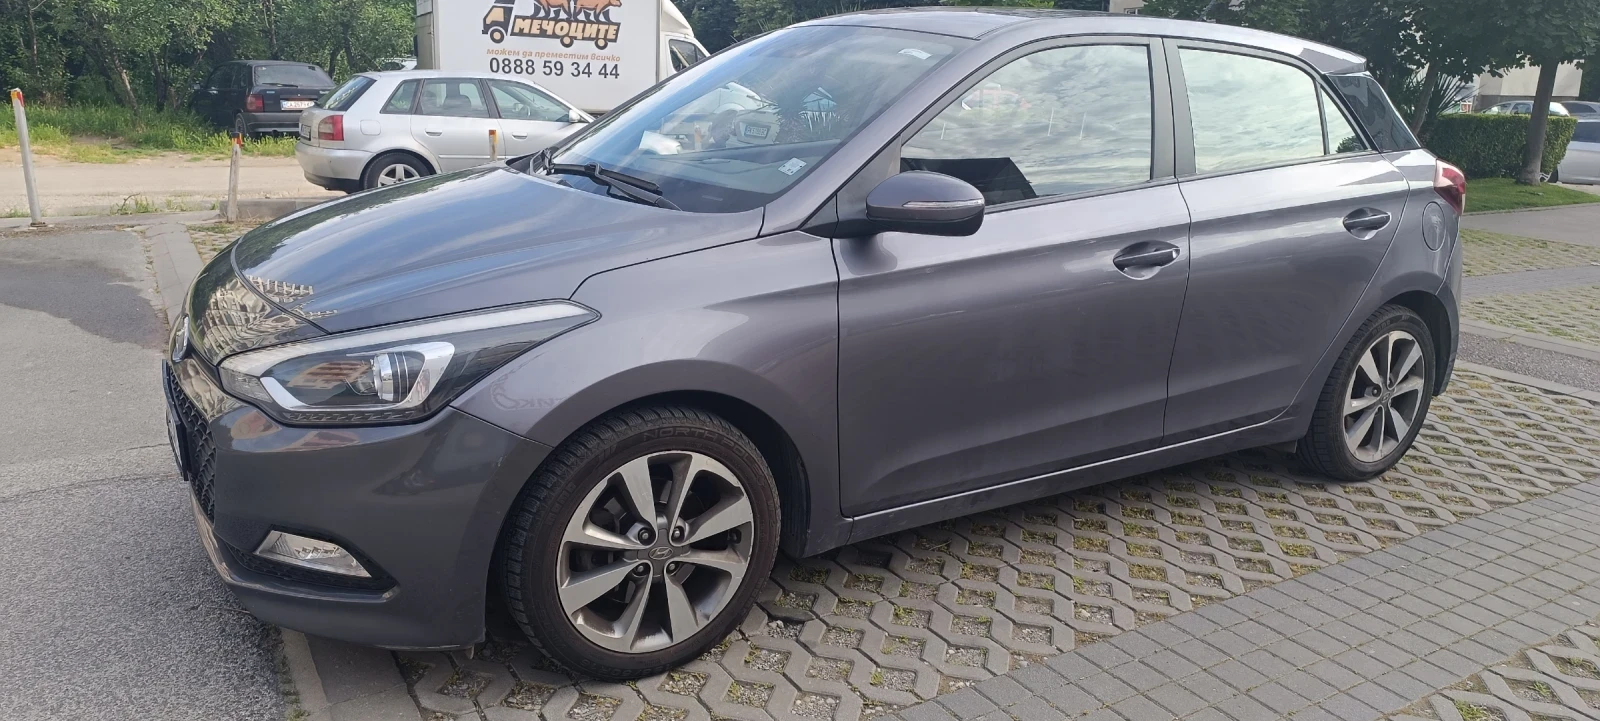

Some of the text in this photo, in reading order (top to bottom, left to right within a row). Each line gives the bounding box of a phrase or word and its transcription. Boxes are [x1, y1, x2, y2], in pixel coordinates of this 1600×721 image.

[513, 18, 618, 40] МЕЧОЦИТЕ
[486, 48, 621, 62] можем да преместим всичко
[489, 57, 620, 79] 0888 59 34 44
[643, 426, 718, 441] NORTH
